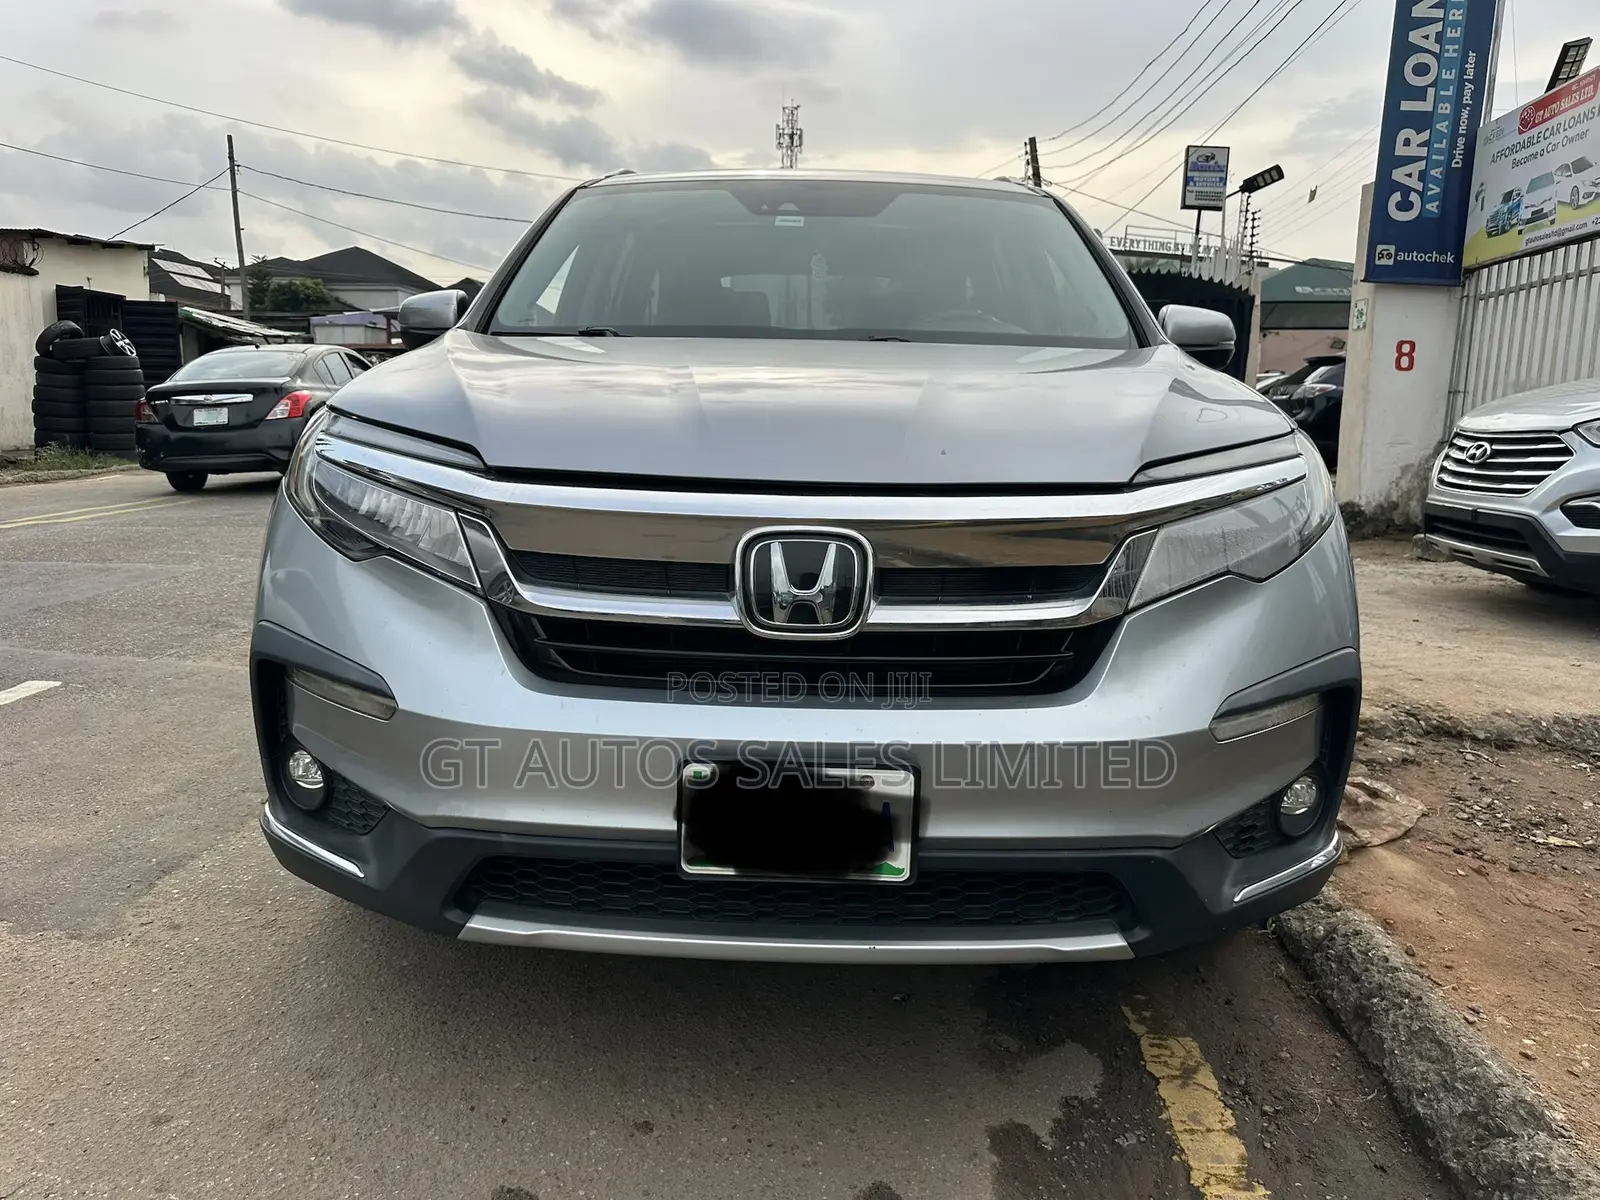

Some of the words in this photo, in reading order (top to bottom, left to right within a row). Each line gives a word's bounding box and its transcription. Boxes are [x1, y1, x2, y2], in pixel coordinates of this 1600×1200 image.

[1400, 0, 1445, 111] LOAN
[1464, 50, 1477, 79] later
[1425, 68, 1455, 214] AVAILABLE
[1443, 0, 1465, 57] HER
[1463, 82, 1474, 104] pay
[1560, 91, 1580, 110] SALES
[1458, 105, 1471, 134] now,
[1451, 136, 1465, 168] Drive
[1490, 130, 1543, 166] AFFORDABLE
[1542, 122, 1561, 141] CAR
[1563, 106, 1597, 132] LOANS
[1511, 150, 1539, 169] Become
[1539, 148, 1545, 157] a
[1545, 142, 1560, 154] Car
[1561, 128, 1590, 148] Owner
[1388, 128, 1431, 222] CAR
[1109, 236, 1172, 252] EVERYTHING
[1396, 250, 1455, 263] autochek
[1394, 339, 1416, 372] 8
